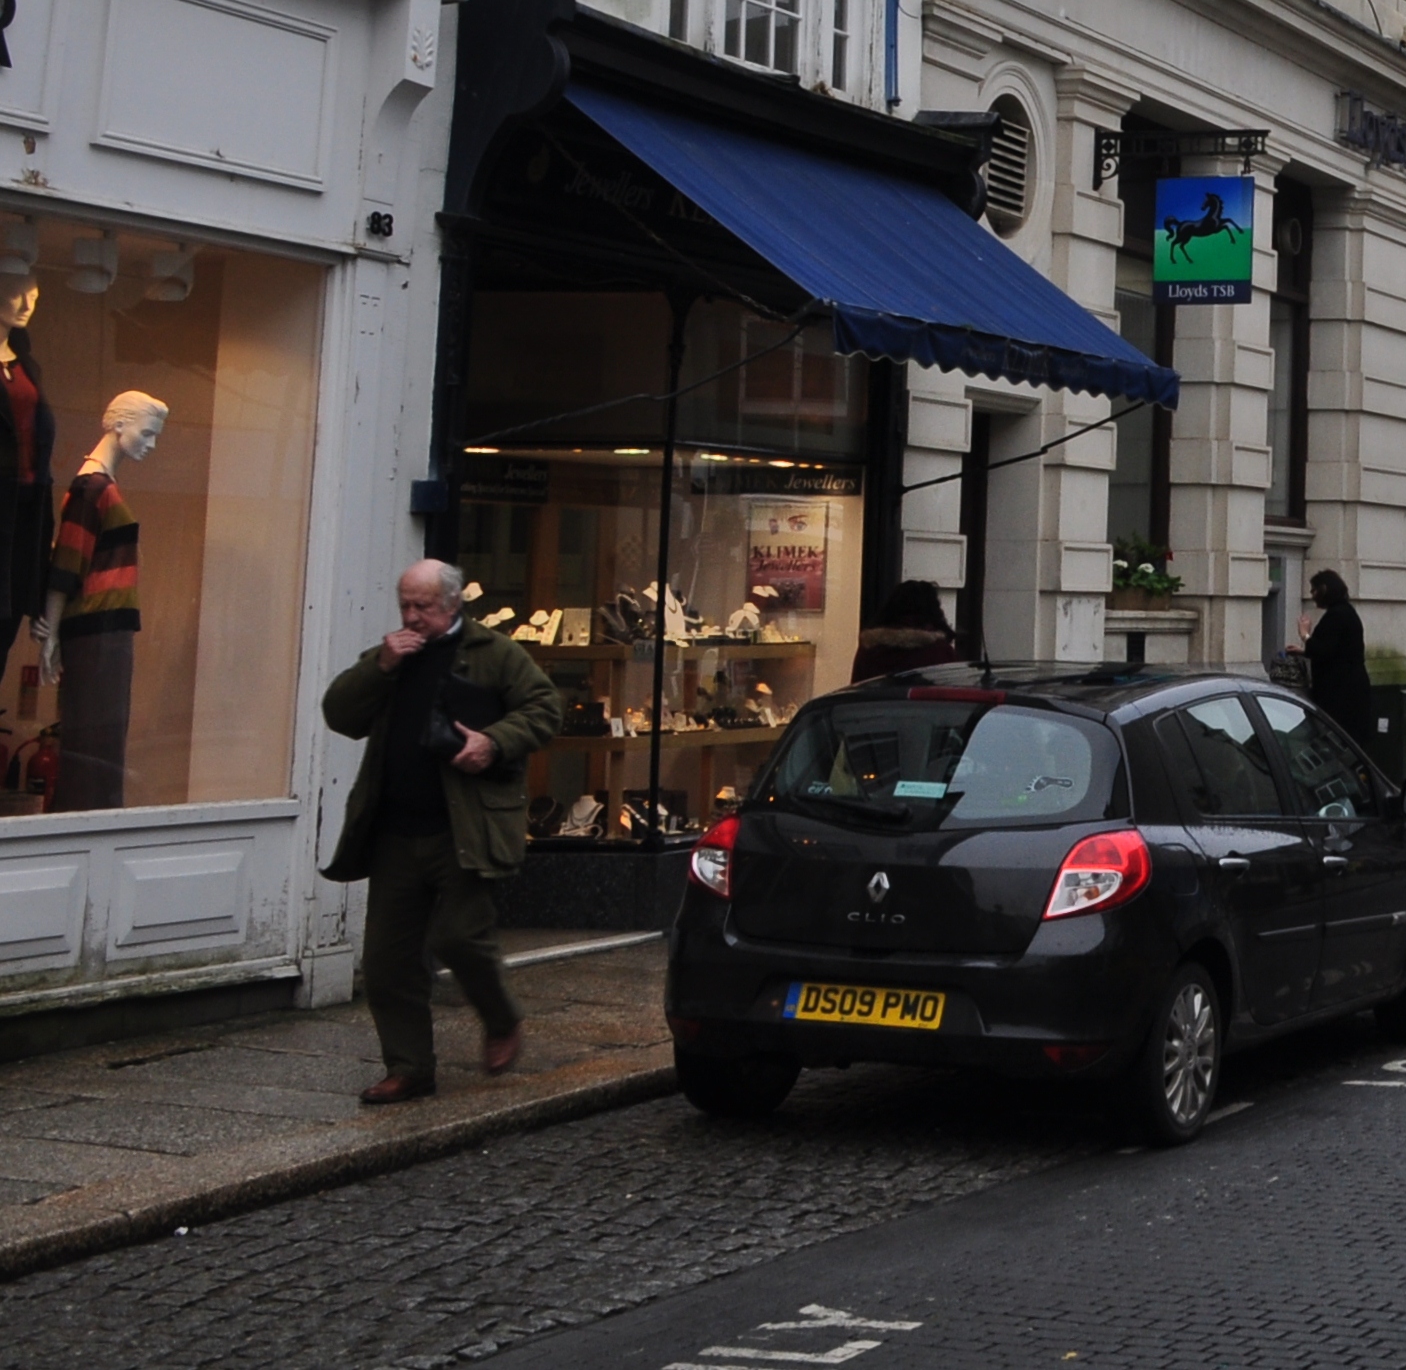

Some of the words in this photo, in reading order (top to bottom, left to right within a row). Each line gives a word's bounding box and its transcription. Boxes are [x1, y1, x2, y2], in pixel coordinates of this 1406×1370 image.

[371, 211, 393, 237] 83
[1168, 284, 1209, 302] Lloyds
[1211, 284, 1235, 297] TSB
[784, 473, 857, 490] Jewellers
[753, 545, 819, 559] KLIMEK
[847, 911, 906, 924] CLIO
[880, 991, 940, 1023] PMO
